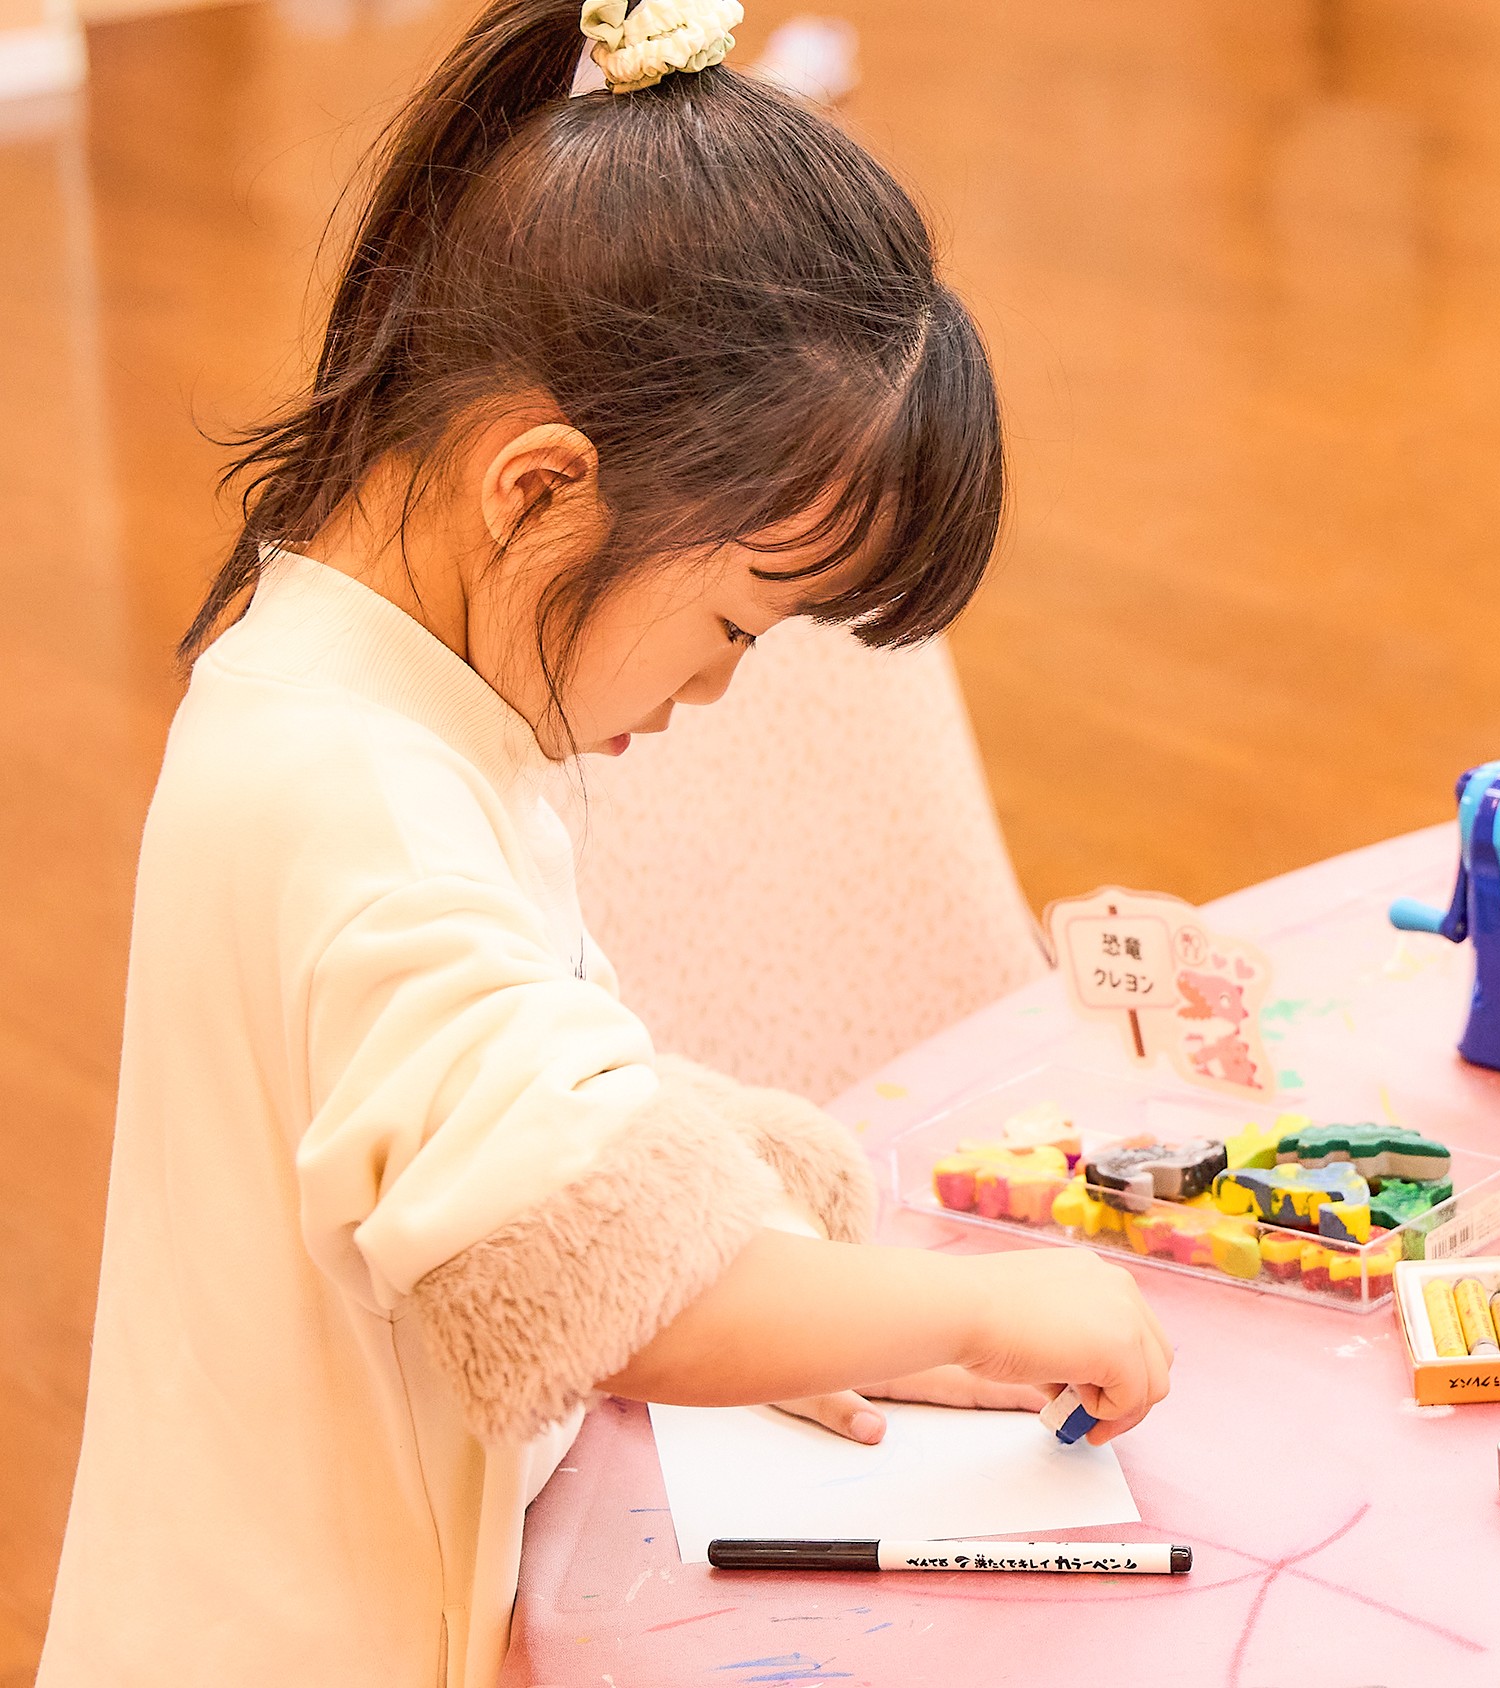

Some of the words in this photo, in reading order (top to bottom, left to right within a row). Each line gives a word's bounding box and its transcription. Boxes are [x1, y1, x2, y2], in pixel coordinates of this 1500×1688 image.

[1103, 933, 1143, 960] 恐竜
[1094, 968, 1153, 994] クレヨン
[1449, 1376, 1490, 1389] クレパス
[1055, 1555, 1122, 1571] カラーペン
